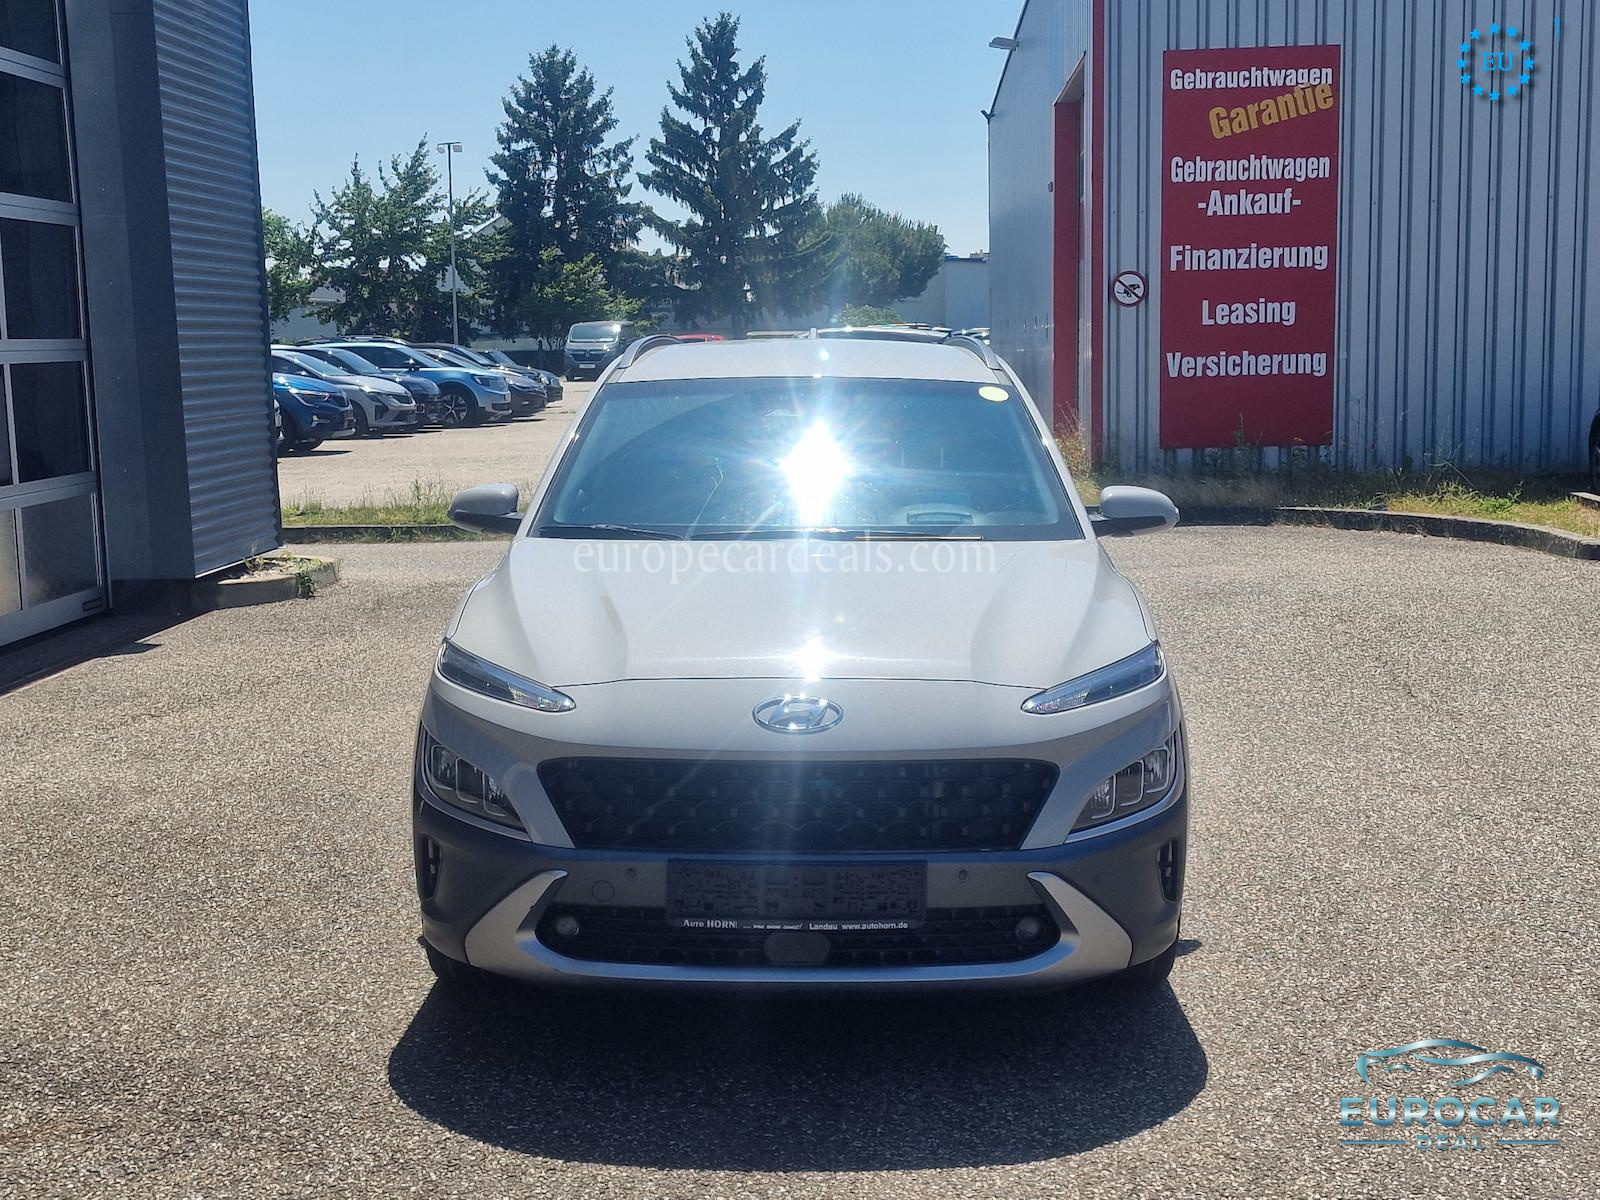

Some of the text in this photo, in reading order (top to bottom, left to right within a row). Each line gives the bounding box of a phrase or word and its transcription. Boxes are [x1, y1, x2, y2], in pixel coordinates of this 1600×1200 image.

[1170, 66, 1333, 91] Gebrauchtwagen
[1208, 83, 1335, 140] Garantie
[1170, 155, 1331, 183] Gebrauchtwagen
[1198, 188, 1302, 216] -Ankauf-
[1169, 243, 1329, 272] Finanzierung
[1201, 298, 1297, 326] Leasing
[1166, 351, 1327, 378] Versicherung
[809, 922, 838, 931] Landau
[841, 921, 908, 931] www.autohorn.de
